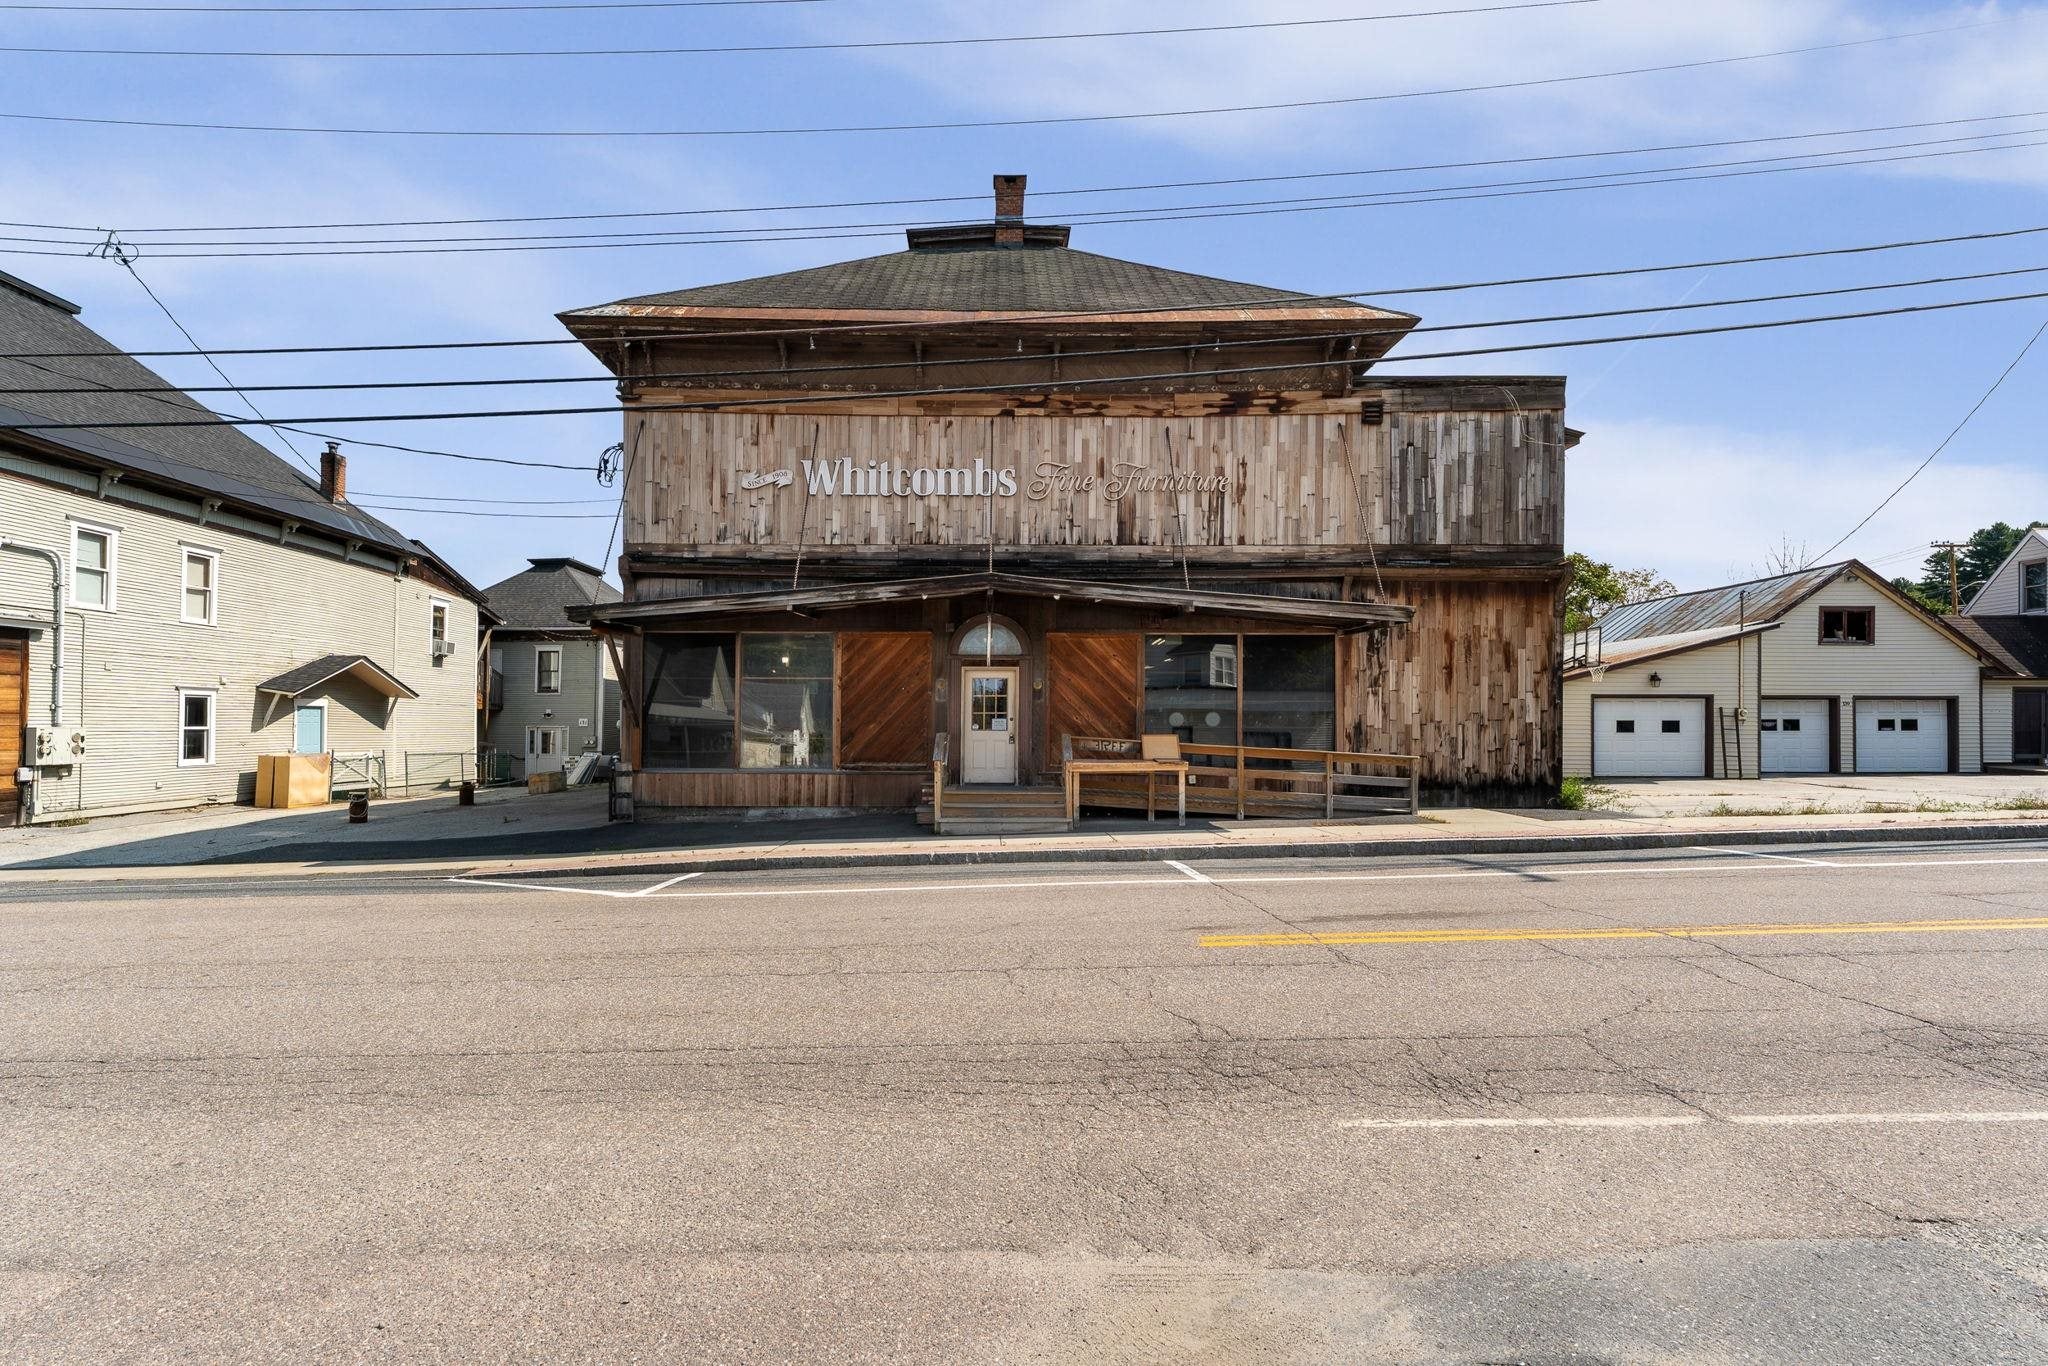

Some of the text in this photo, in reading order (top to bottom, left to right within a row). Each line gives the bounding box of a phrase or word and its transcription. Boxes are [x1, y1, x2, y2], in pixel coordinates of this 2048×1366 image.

[800, 457, 1230, 501] Whitcombs Fine Furniture
